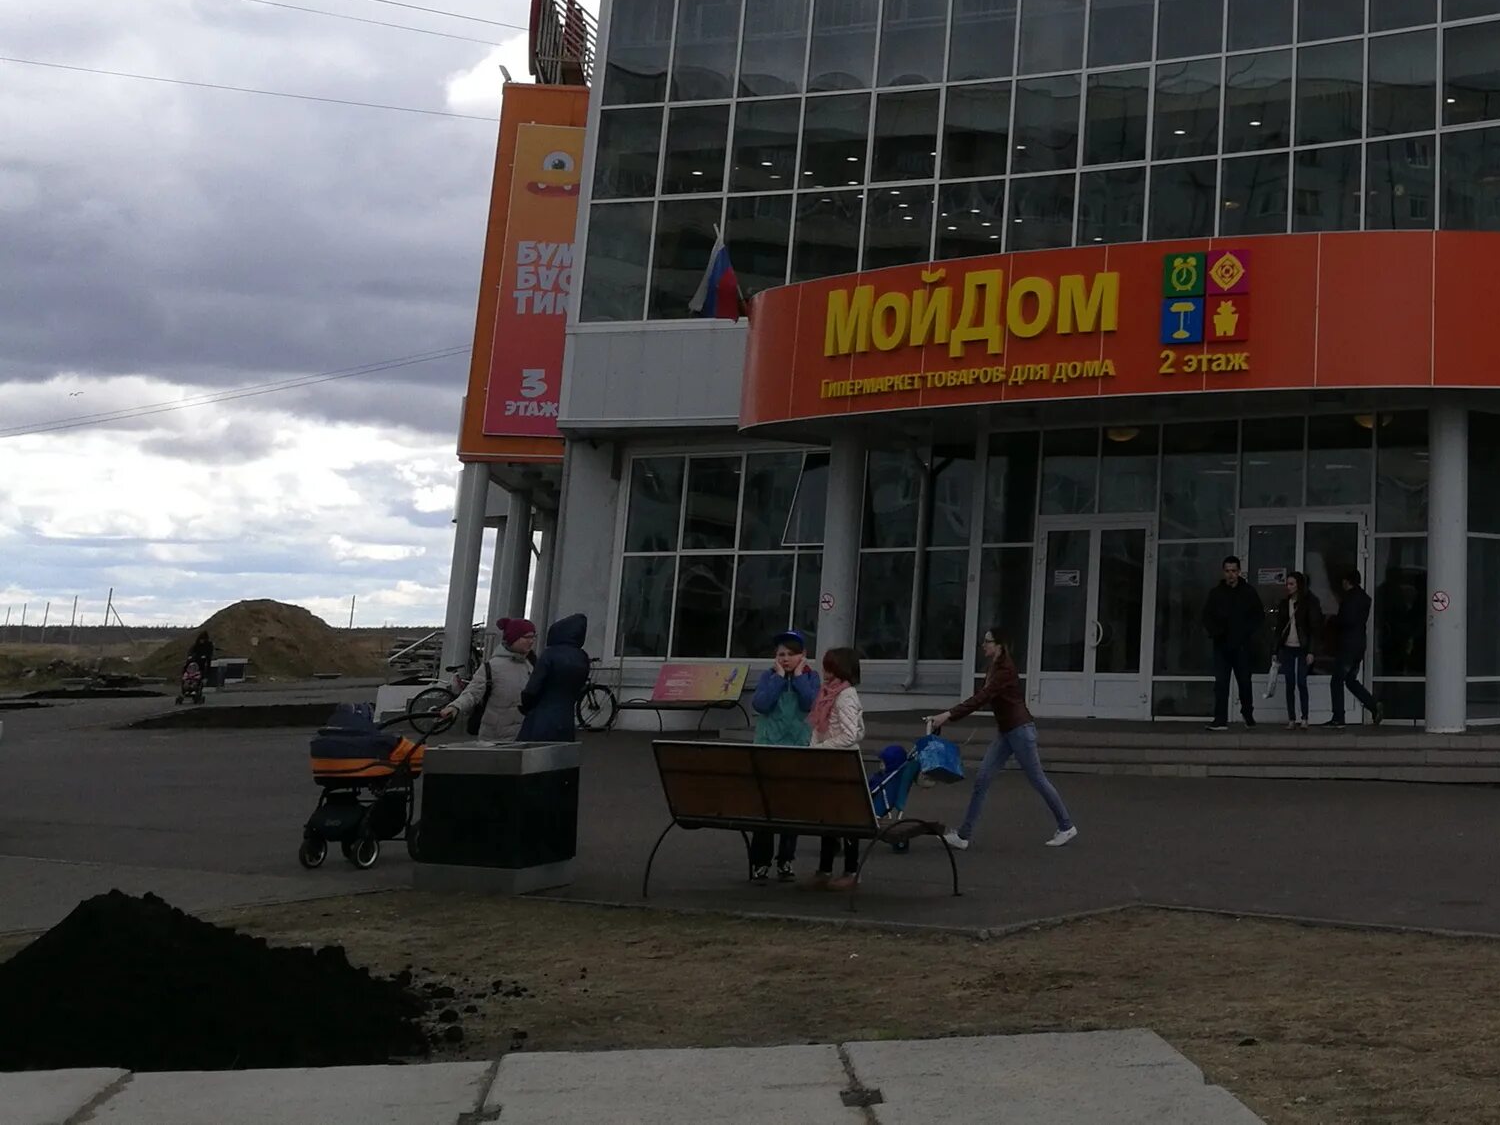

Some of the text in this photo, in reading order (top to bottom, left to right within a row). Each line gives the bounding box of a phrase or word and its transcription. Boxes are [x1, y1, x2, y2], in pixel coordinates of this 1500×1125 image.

[516, 240, 575, 266] БУМ
[925, 365, 1003, 389] ТОВАРОВ
[1008, 361, 1050, 385] ДЛЯ
[1052, 358, 1116, 382] ДОМА
[1159, 349, 1249, 375] 2 этаж
[520, 368, 548, 399] 3
[504, 400, 560, 417] ЭТАЖ
